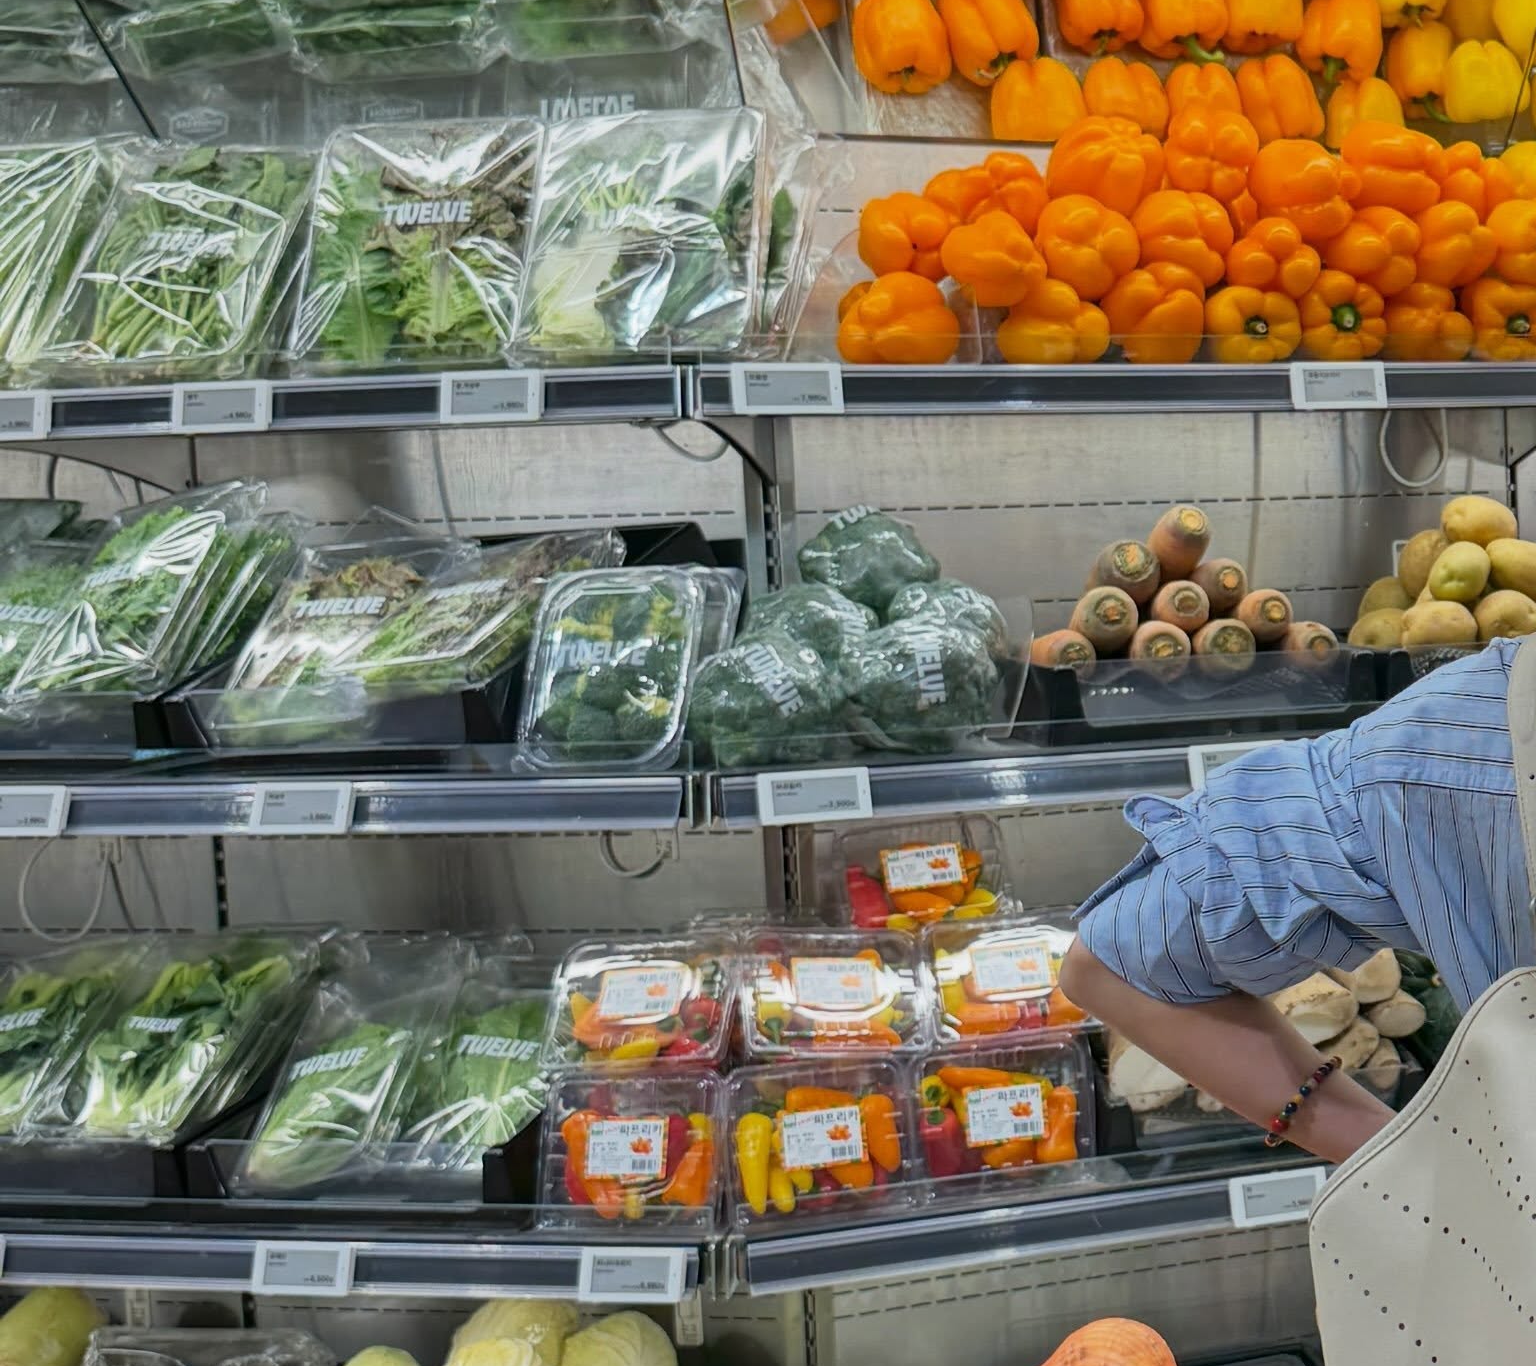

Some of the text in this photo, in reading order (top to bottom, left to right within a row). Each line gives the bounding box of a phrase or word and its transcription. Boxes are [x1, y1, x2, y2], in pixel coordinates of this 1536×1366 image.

[384, 200, 473, 226] TWELVE
[295, 596, 387, 619] TWELVE
[458, 1035, 541, 1061] TWELVE
[289, 1047, 369, 1082] TWELVE
